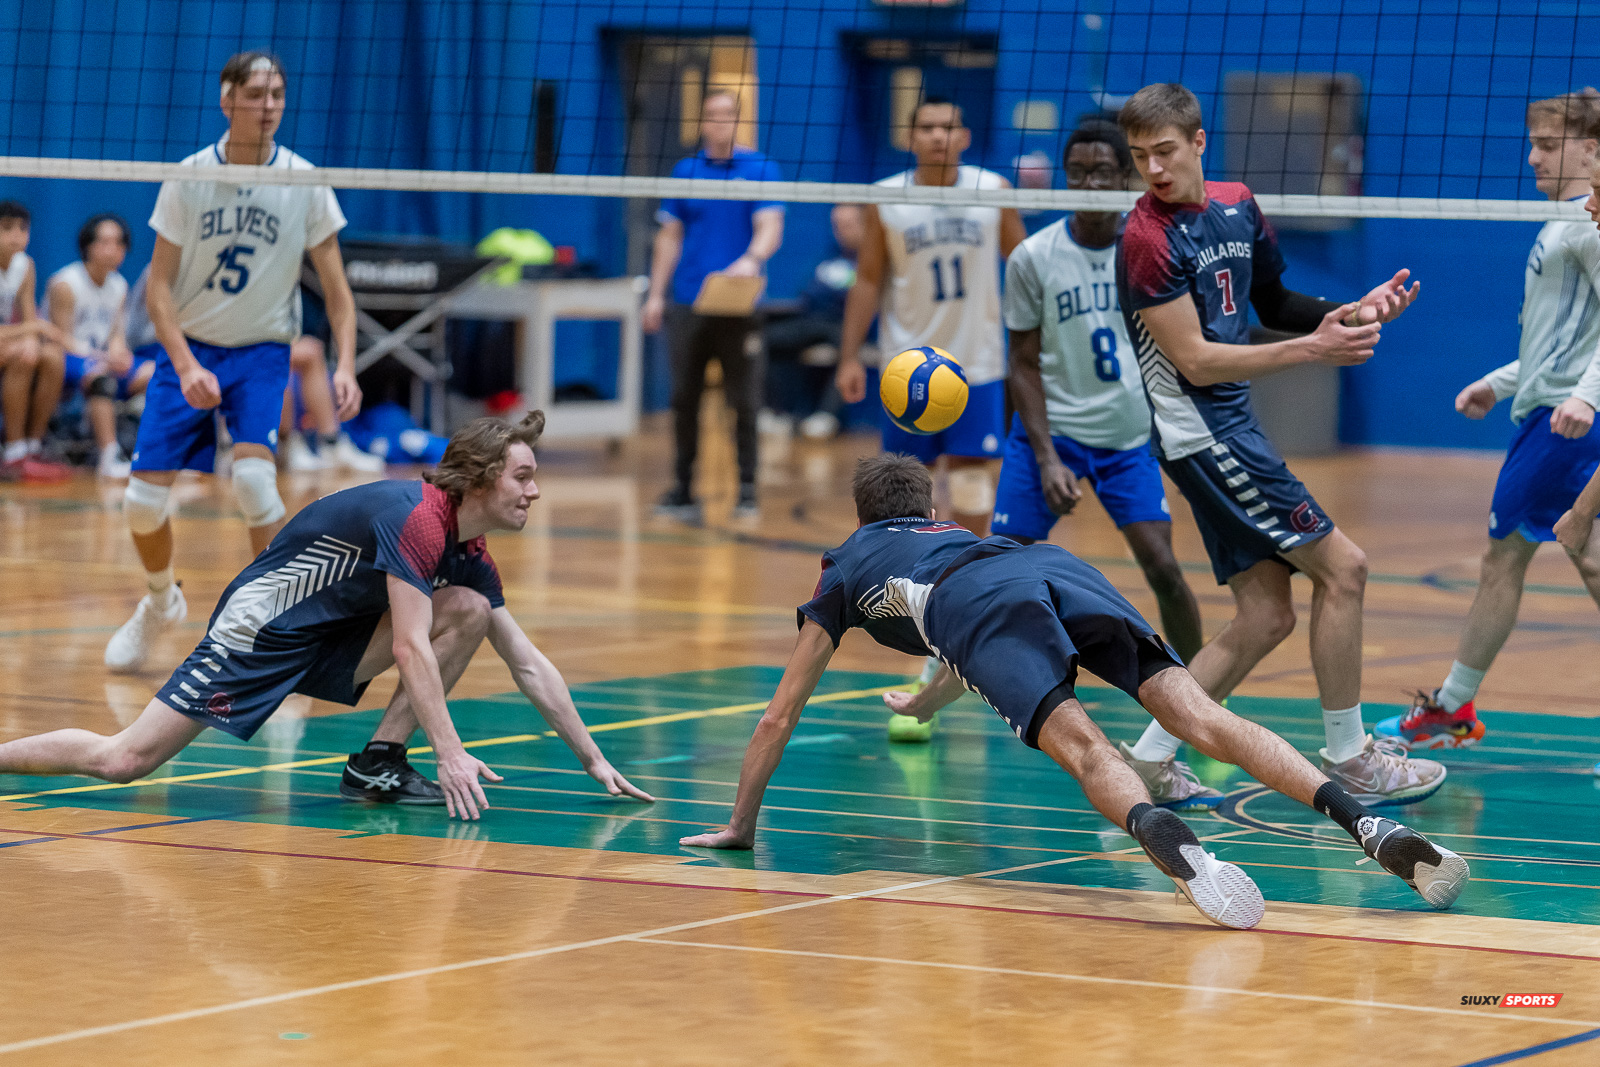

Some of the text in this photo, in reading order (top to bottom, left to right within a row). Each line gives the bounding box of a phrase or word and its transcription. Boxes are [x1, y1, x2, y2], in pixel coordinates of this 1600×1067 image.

[207, 244, 256, 295] 15
[930, 254, 966, 302] 11
[1215, 268, 1237, 316] 7
[1055, 282, 1122, 324] BLU
[1091, 327, 1121, 382] 8
